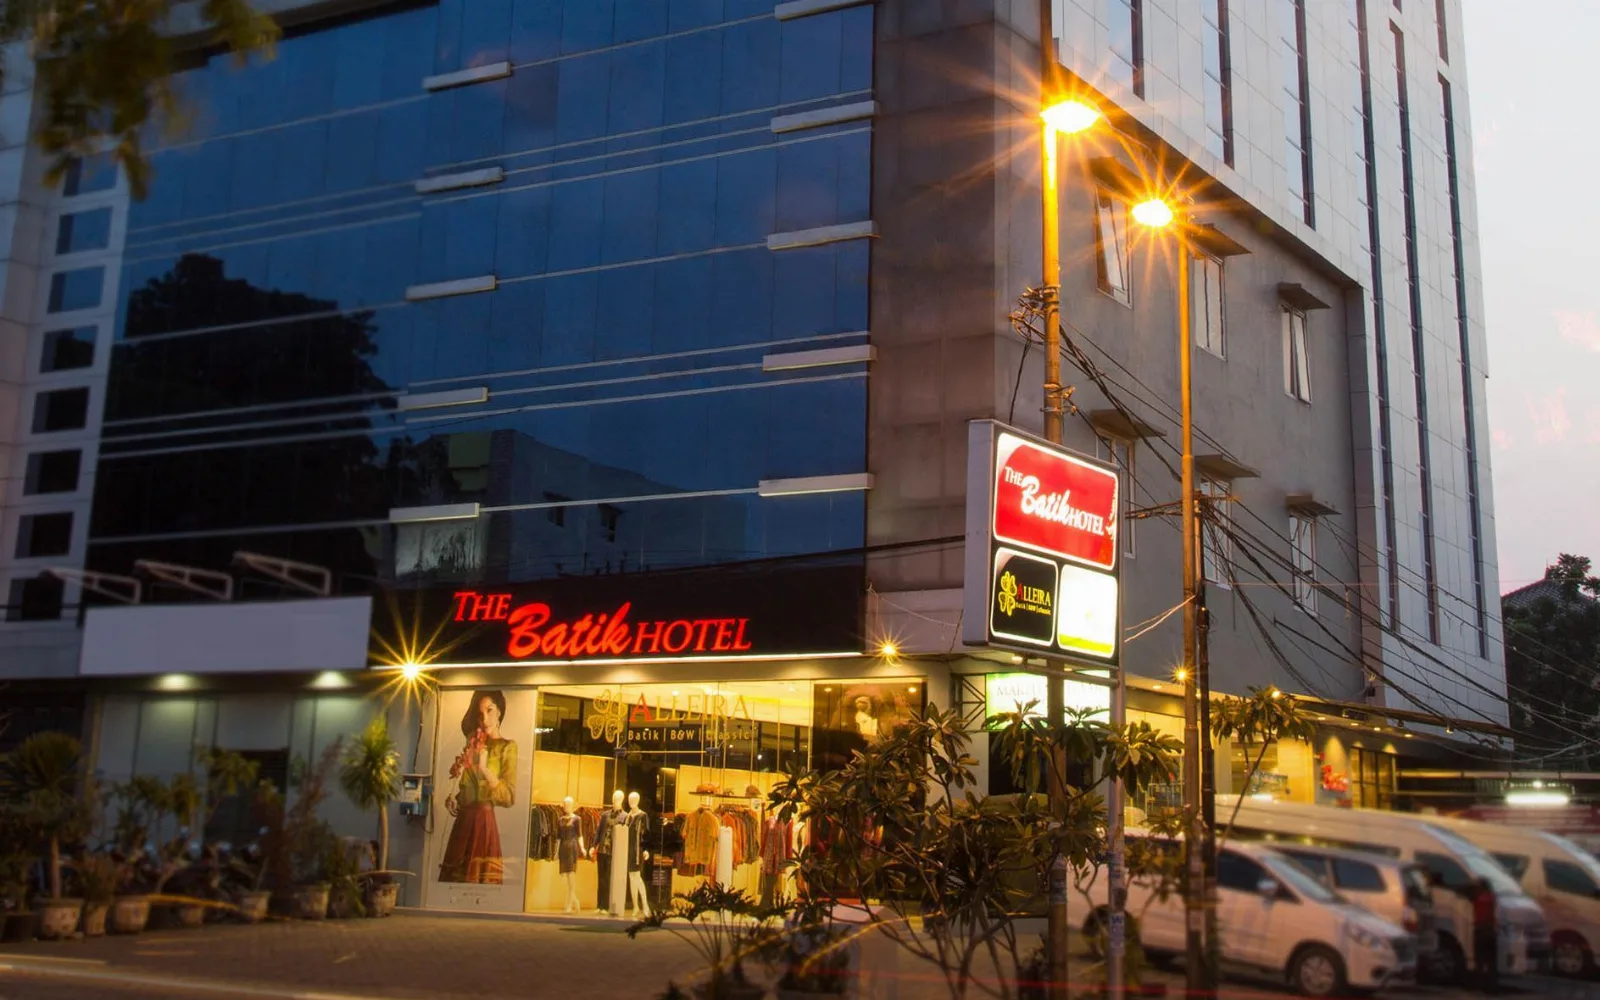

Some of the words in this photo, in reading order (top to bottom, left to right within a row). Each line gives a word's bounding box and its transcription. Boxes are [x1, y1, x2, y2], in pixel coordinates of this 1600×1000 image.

[1005, 466, 1023, 488] THE
[1021, 475, 1071, 526] Batik
[1067, 506, 1105, 536] HOTEL
[1016, 583, 1051, 607] ALLEIRA
[454, 591, 512, 621] THE
[507, 601, 632, 658] Batik
[631, 618, 752, 653] HOTEL
[629, 692, 751, 722] ALLEIRA
[628, 729, 659, 740] Batik
[670, 729, 695, 740] B&W
